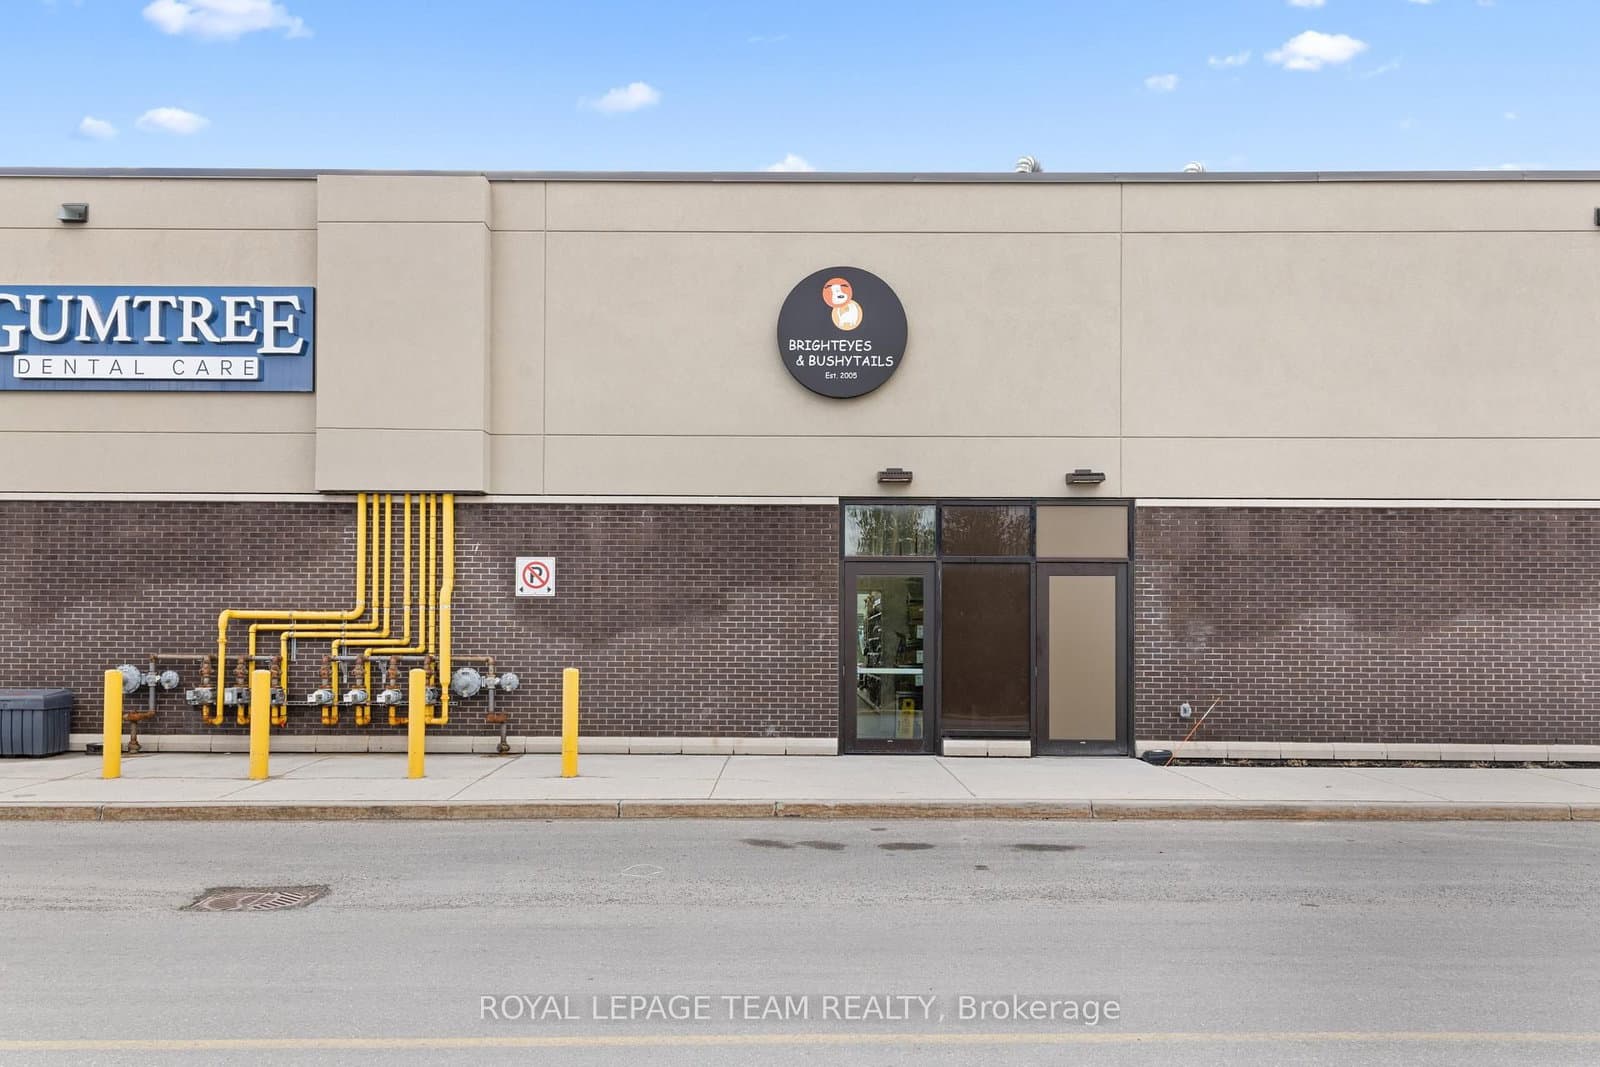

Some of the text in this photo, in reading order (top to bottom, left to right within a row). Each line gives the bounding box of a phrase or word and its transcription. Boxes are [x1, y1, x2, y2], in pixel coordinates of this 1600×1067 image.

[788, 339, 872, 352] BRIGHTEYES
[18, 358, 255, 376] DENTAL CARE
[795, 354, 894, 367] & BUSHYTAILS
[839, 371, 858, 380] 2005
